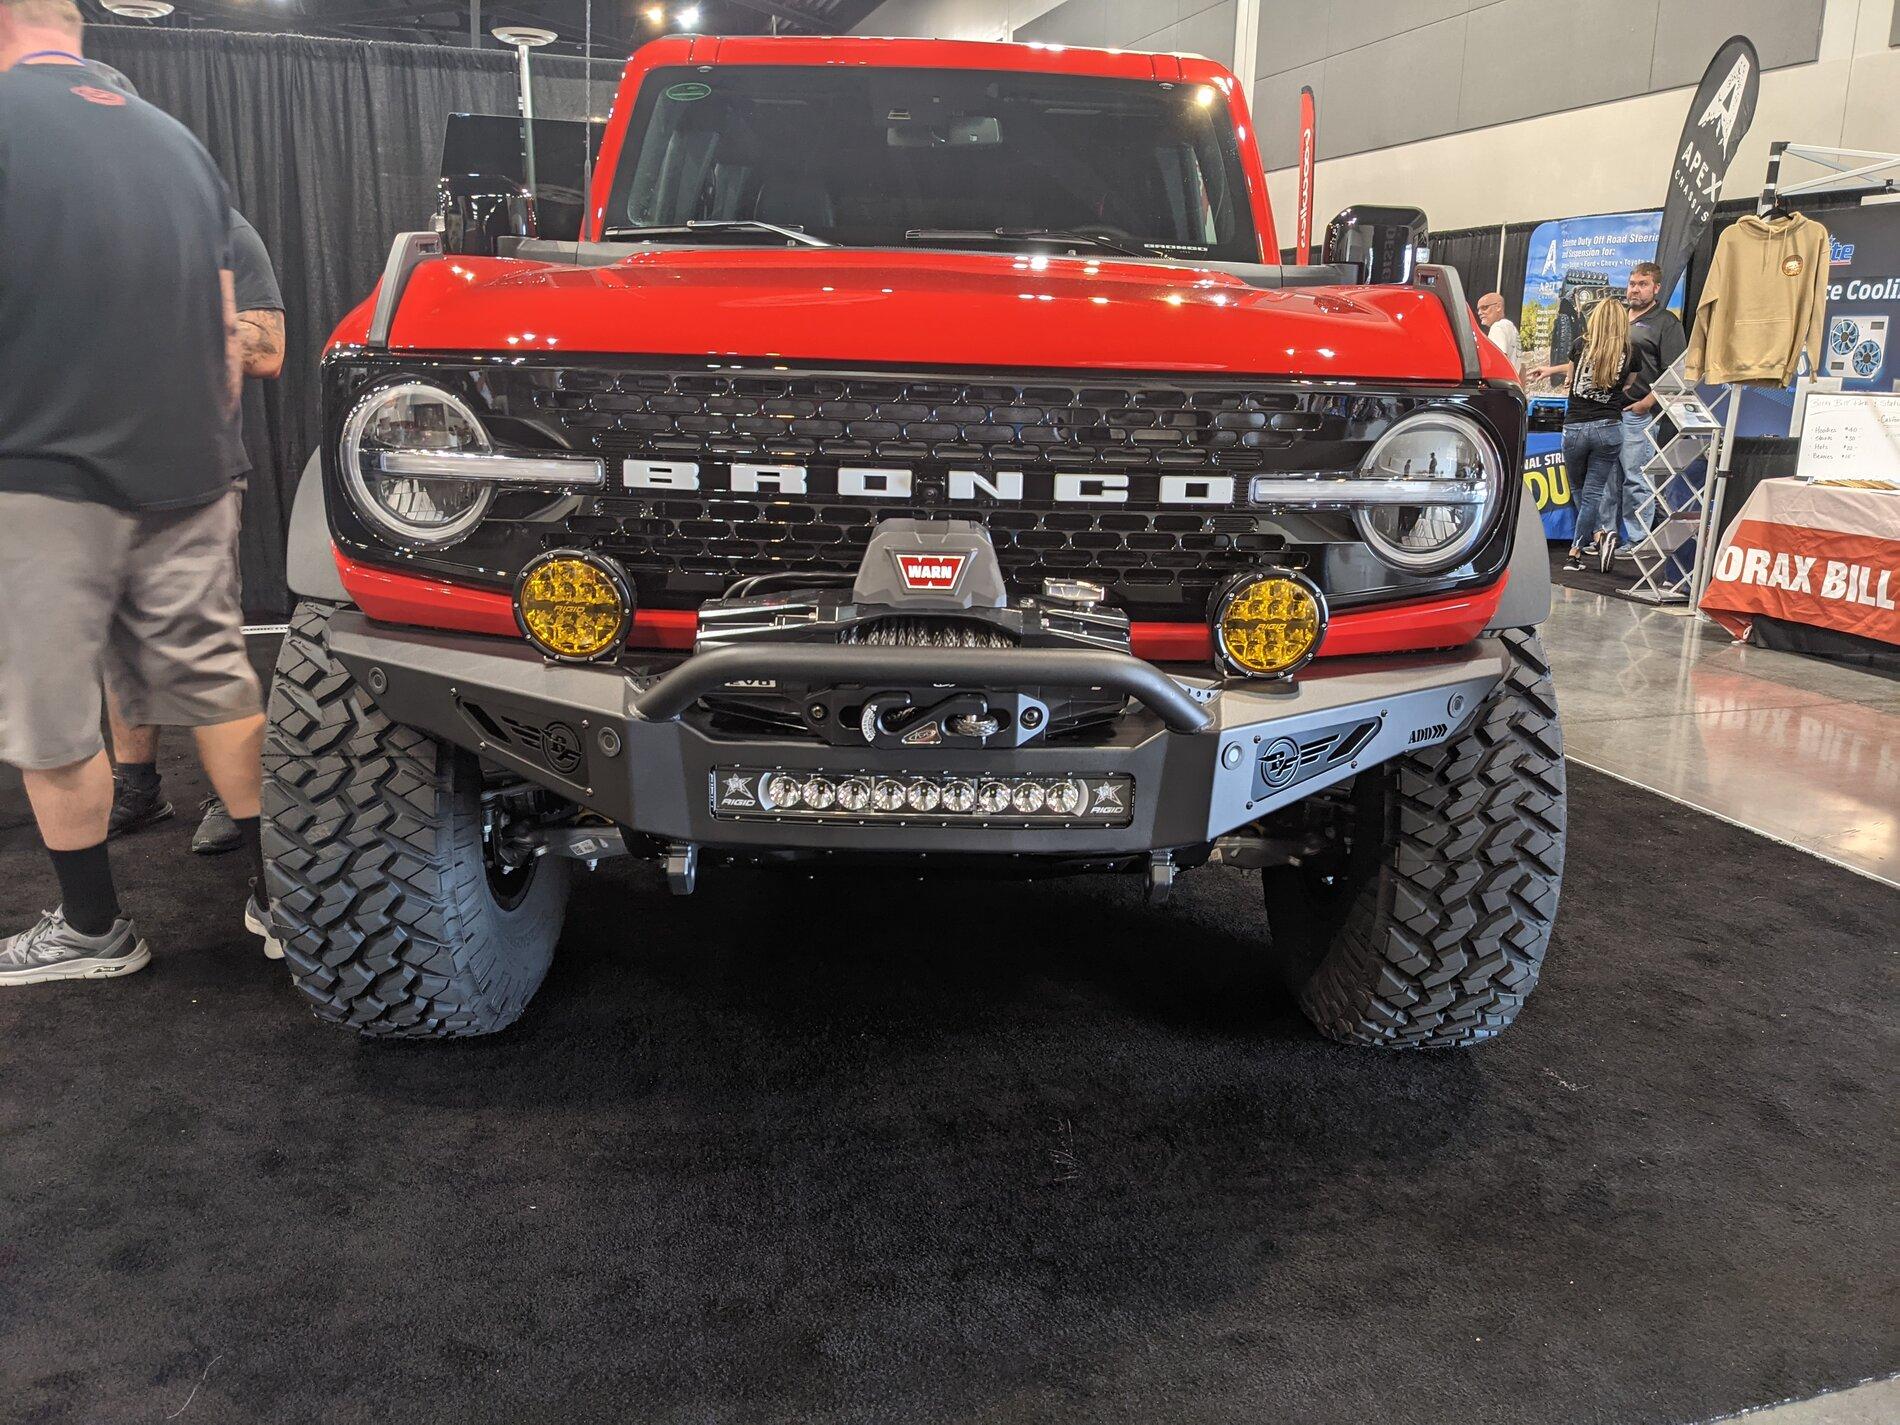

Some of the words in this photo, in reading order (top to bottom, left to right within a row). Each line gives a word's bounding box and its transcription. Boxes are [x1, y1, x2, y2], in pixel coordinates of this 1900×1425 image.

[1681, 140, 1722, 203] APEX
[1674, 169, 1710, 222] CHASSIS
[1577, 236, 1591, 247] Duty
[1593, 235, 1605, 245] Off
[1606, 233, 1627, 244] Road
[1601, 247, 1616, 257] for:
[1584, 259, 1596, 268] Ford
[1601, 258, 1618, 268] Chevy
[1846, 278, 1900, 300] Cooli
[622, 458, 1235, 504] BRONCO
[907, 565, 953, 579] WARN
[1820, 560, 1895, 611] BILL
[553, 605, 586, 613] RIGID
[1408, 727, 1433, 744] ADD
[721, 798, 757, 807] RIGID
[1090, 806, 1125, 814] RIGID
